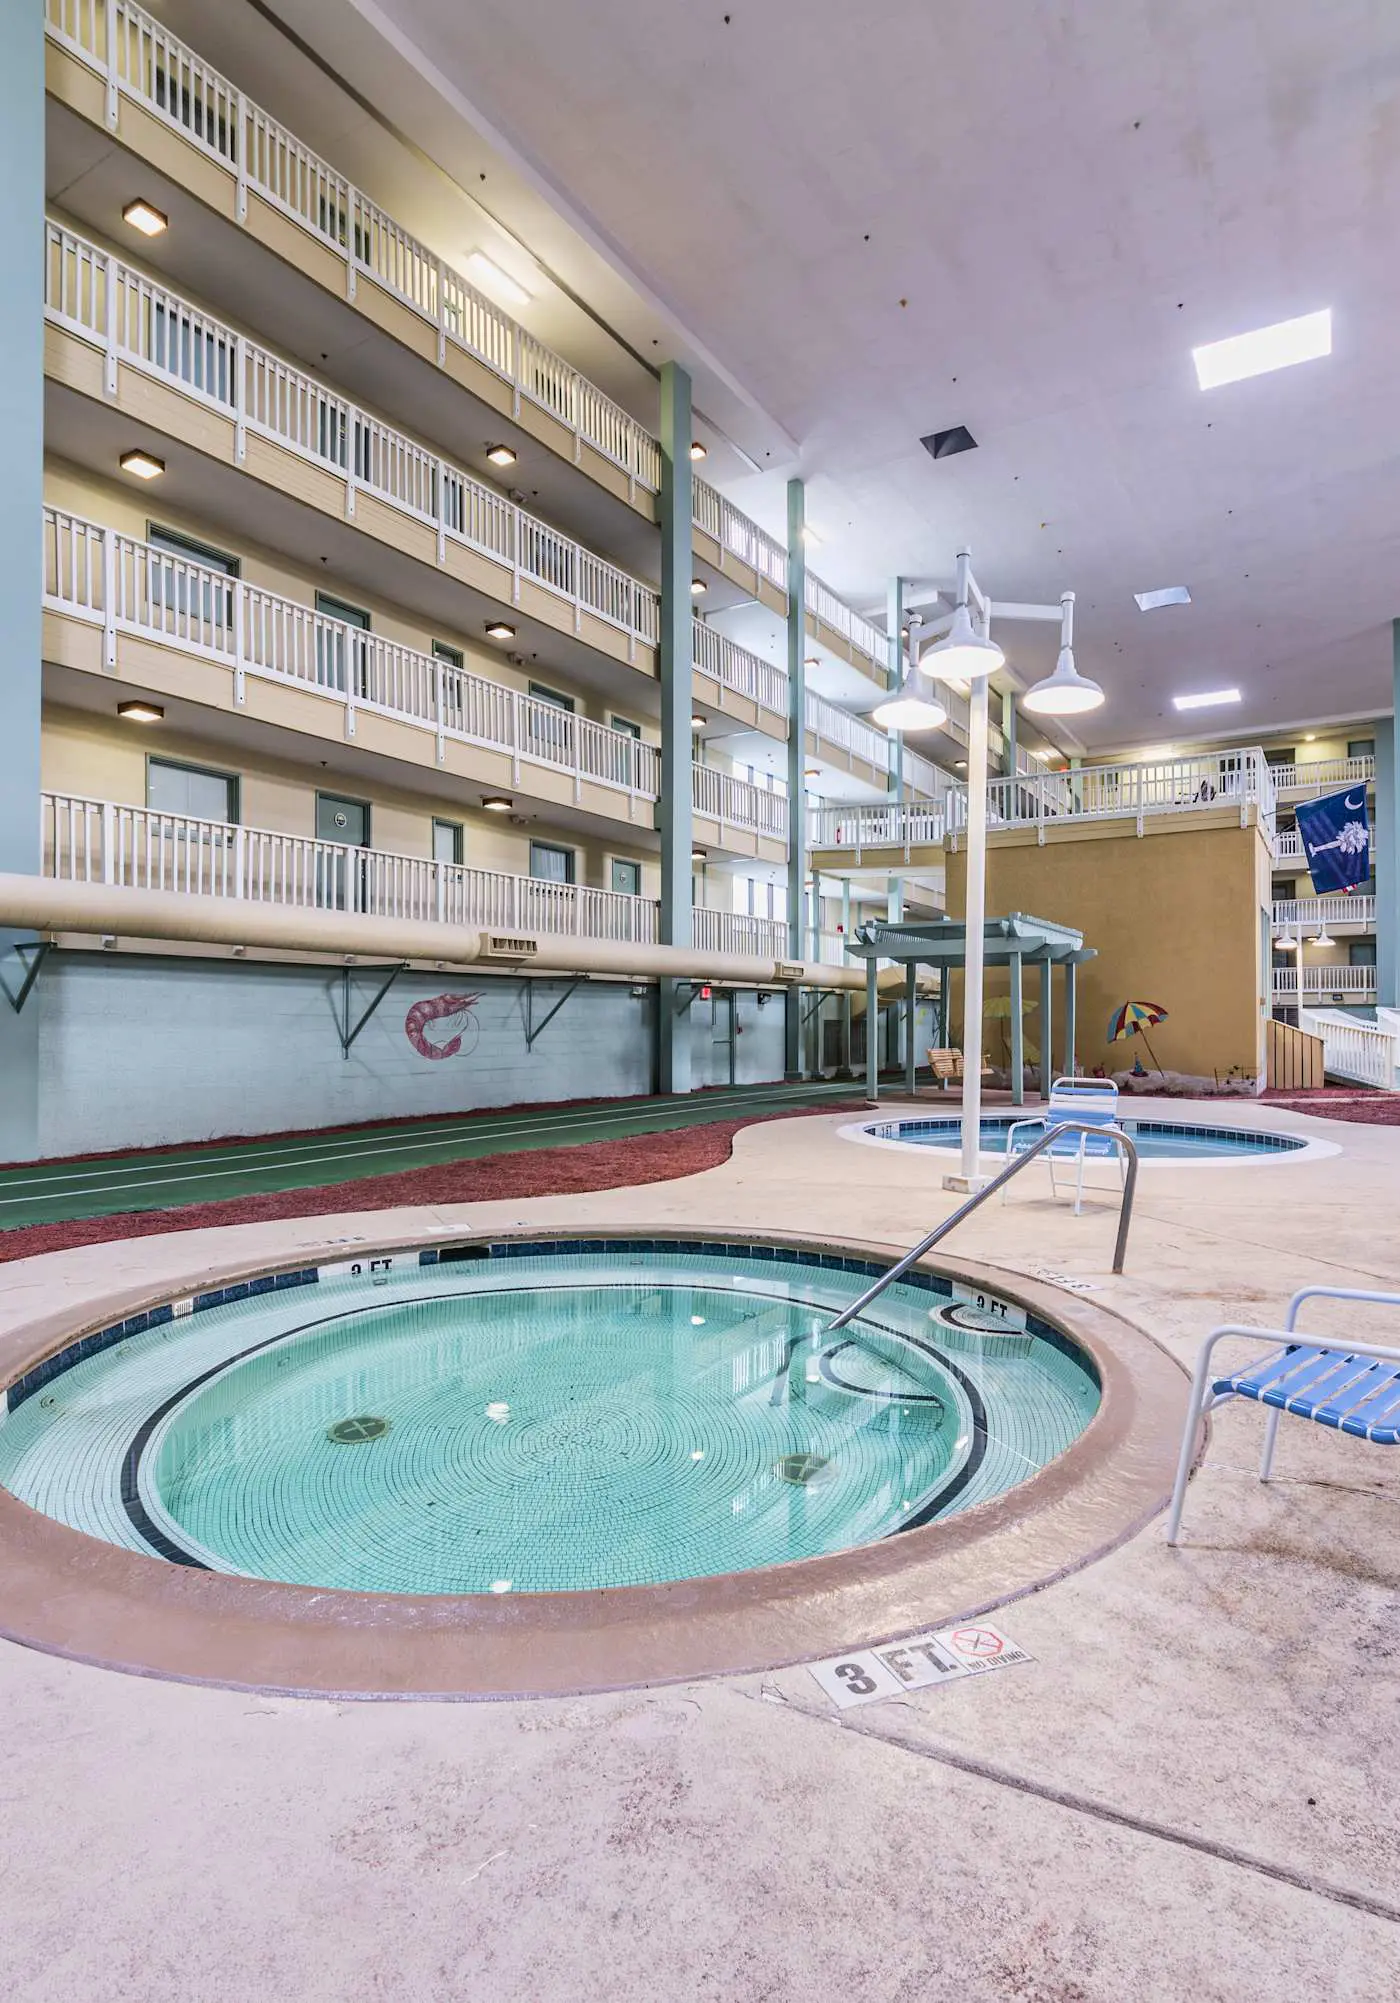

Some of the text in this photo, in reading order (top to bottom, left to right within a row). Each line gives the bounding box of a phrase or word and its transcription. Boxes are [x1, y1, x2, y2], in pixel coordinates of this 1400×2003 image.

[834, 1642, 958, 1694] 3 FT.
[968, 1650, 1028, 1670] NO DIVING
